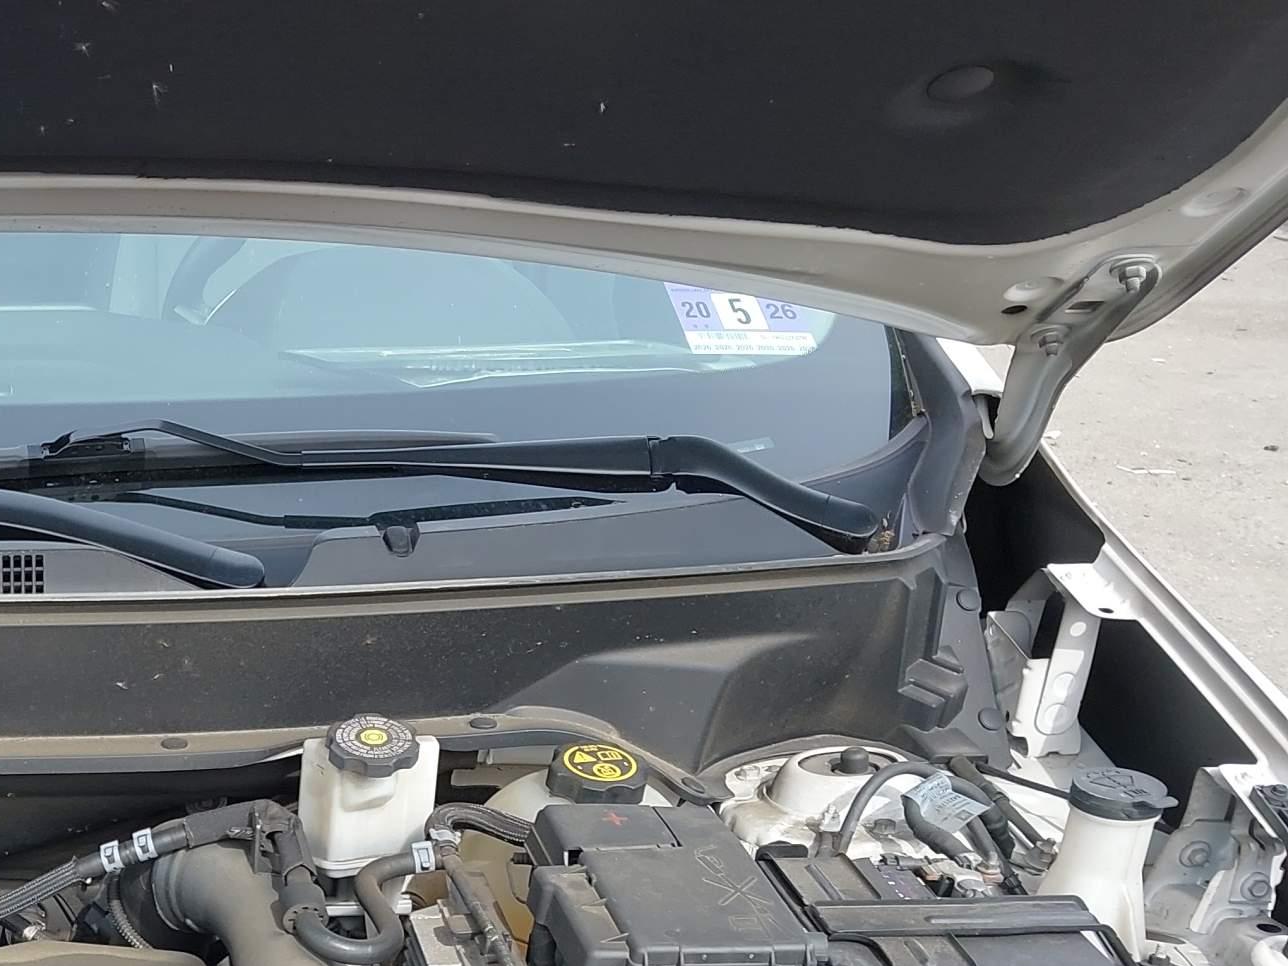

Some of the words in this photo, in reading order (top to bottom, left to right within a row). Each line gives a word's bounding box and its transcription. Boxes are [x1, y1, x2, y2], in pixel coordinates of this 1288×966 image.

[681, 301, 710, 319] 20
[728, 298, 752, 325] 5
[766, 303, 797, 320] 26
